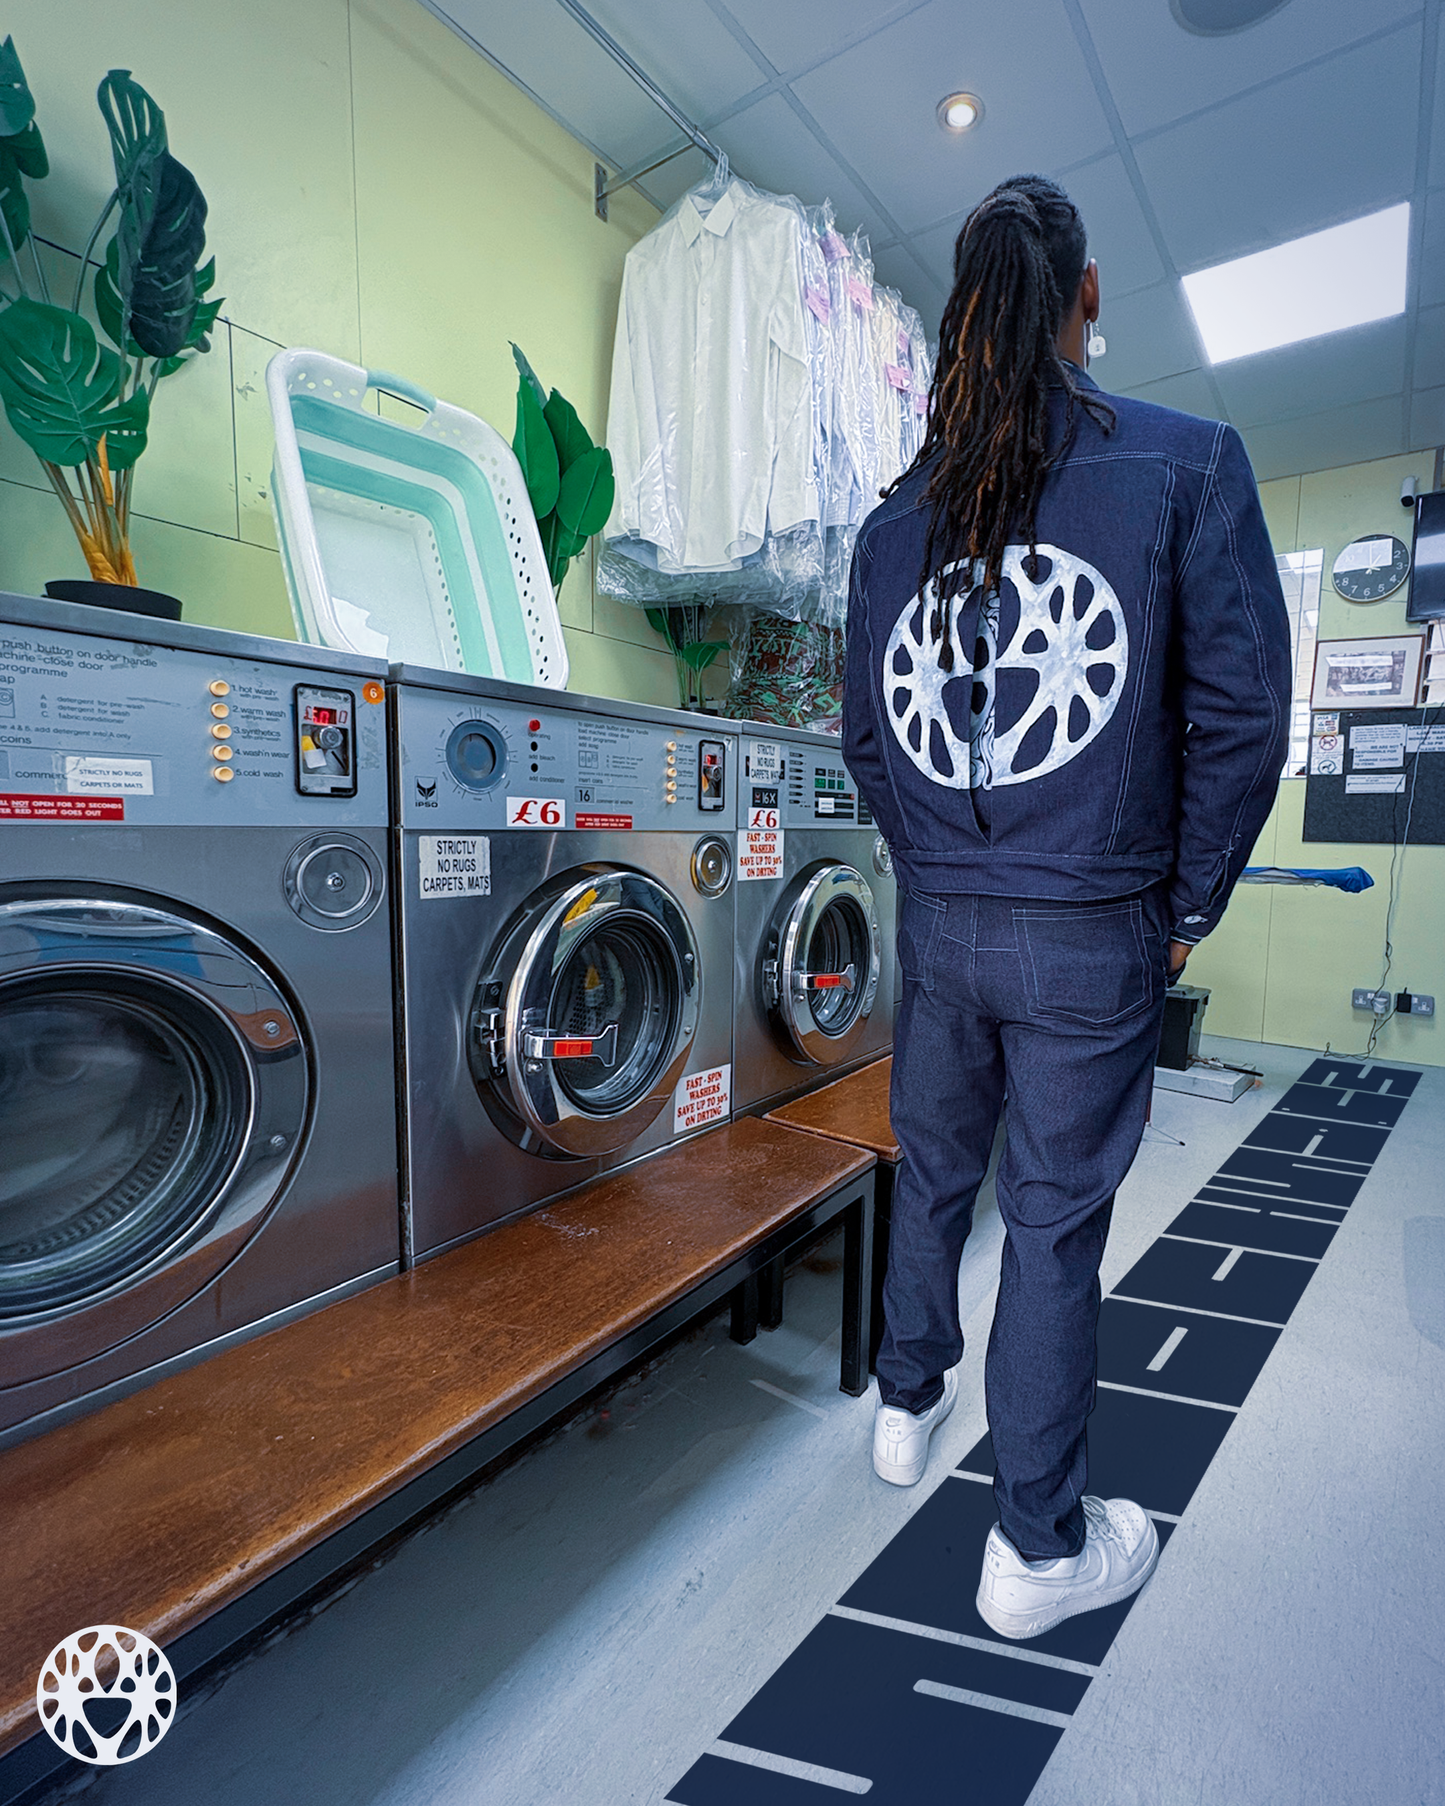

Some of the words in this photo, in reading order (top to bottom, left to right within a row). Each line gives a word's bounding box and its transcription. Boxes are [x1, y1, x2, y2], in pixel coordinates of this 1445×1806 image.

[1393, 550, 1402, 559] 2
[1396, 562, 1404, 570] 3
[1341, 577, 1350, 586] 8
[1389, 574, 1397, 583] 4
[1351, 585, 1358, 594] 7
[1363, 587, 1370, 596] 6
[1378, 583, 1385, 592] 5
[2, 640, 32, 651] push
[36, 643, 74, 657] button
[77, 650, 91, 659] on
[94, 652, 119, 662] door
[123, 655, 158, 667] handle
[78, 660, 104, 671] door
[254, 688, 276, 696] wash
[370, 687, 378, 699] 6
[57, 695, 94, 706] detergent
[57, 704, 95, 714] detergent
[265, 710, 287, 718] wash
[52, 728, 91, 737] detergent
[116, 733, 132, 741] only
[0, 735, 32, 745] coins
[757, 743, 775, 756] STRICTLY
[271, 751, 291, 759] wear
[764, 758, 775, 768] RUGS
[79, 769, 111, 777] STRICTLY
[263, 770, 284, 778] wash
[539, 776, 566, 784] conditioner
[578, 789, 591, 803] 16
[12, 800, 29, 808] NOT
[511, 800, 560, 825] £6
[751, 810, 777, 828] £6
[746, 832, 760, 842] FAST
[764, 832, 777, 842] SPIN
[436, 840, 477, 855] STRICTLY
[749, 844, 775, 854] WASHERS
[437, 858, 451, 873] NO
[452, 858, 477, 873] RUGS
[740, 857, 754, 866] SAVE
[756, 856, 764, 866] UP
[764, 856, 772, 865] TO
[747, 869, 755, 877] ON
[756, 867, 777, 877] DRYING
[423, 876, 466, 893] CARPETS,
[467, 876, 489, 890] MATS
[686, 1076, 702, 1091] FAST
[707, 1070, 722, 1083] SPIN
[689, 1083, 720, 1100] WASHERS
[677, 1102, 695, 1118] SAVE
[696, 1100, 706, 1110] UP
[707, 1096, 715, 1107] TO
[685, 1115, 696, 1127] ON
[697, 1106, 722, 1123] DRYING
